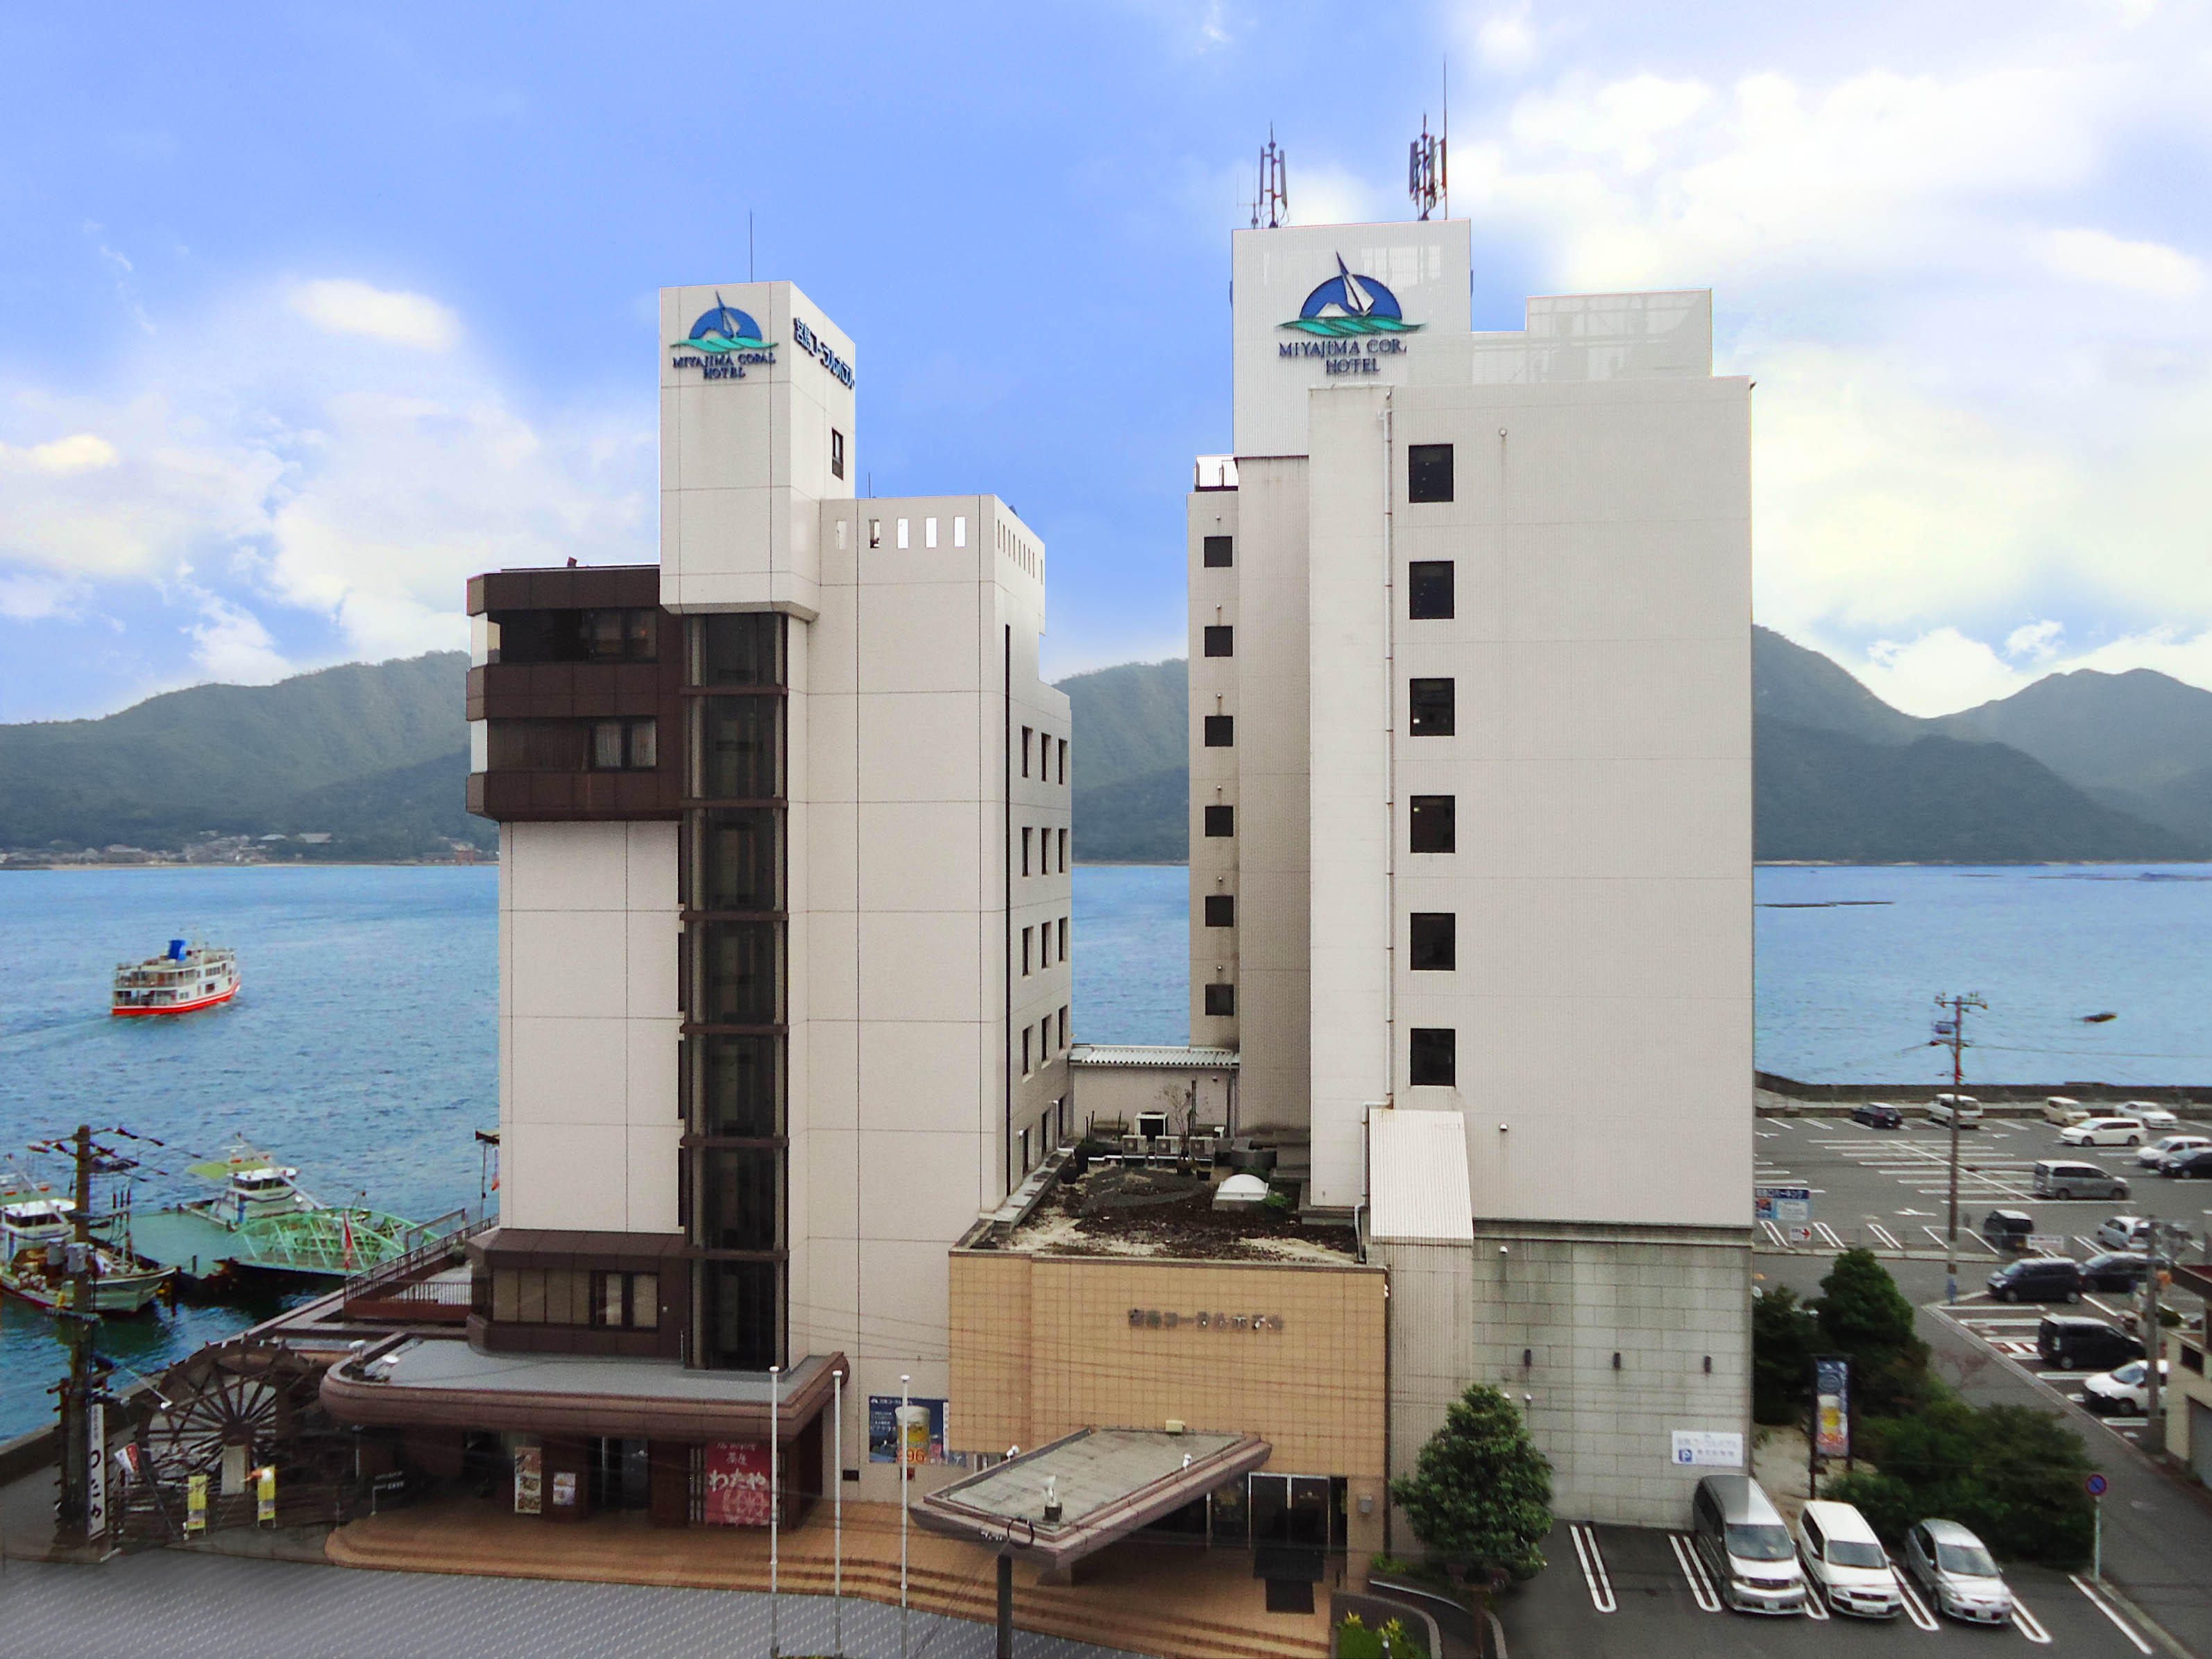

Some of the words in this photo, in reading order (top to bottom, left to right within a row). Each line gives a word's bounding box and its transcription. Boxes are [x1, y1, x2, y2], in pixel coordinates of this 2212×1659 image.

[1276, 340, 1360, 358] MIYAJIMA
[672, 355, 734, 368] MIYAJIMA
[738, 352, 776, 365] CORAL
[1326, 358, 1381, 373] HOTEL
[703, 366, 746, 380] HOTEL
[708, 1467, 767, 1493] わたや
